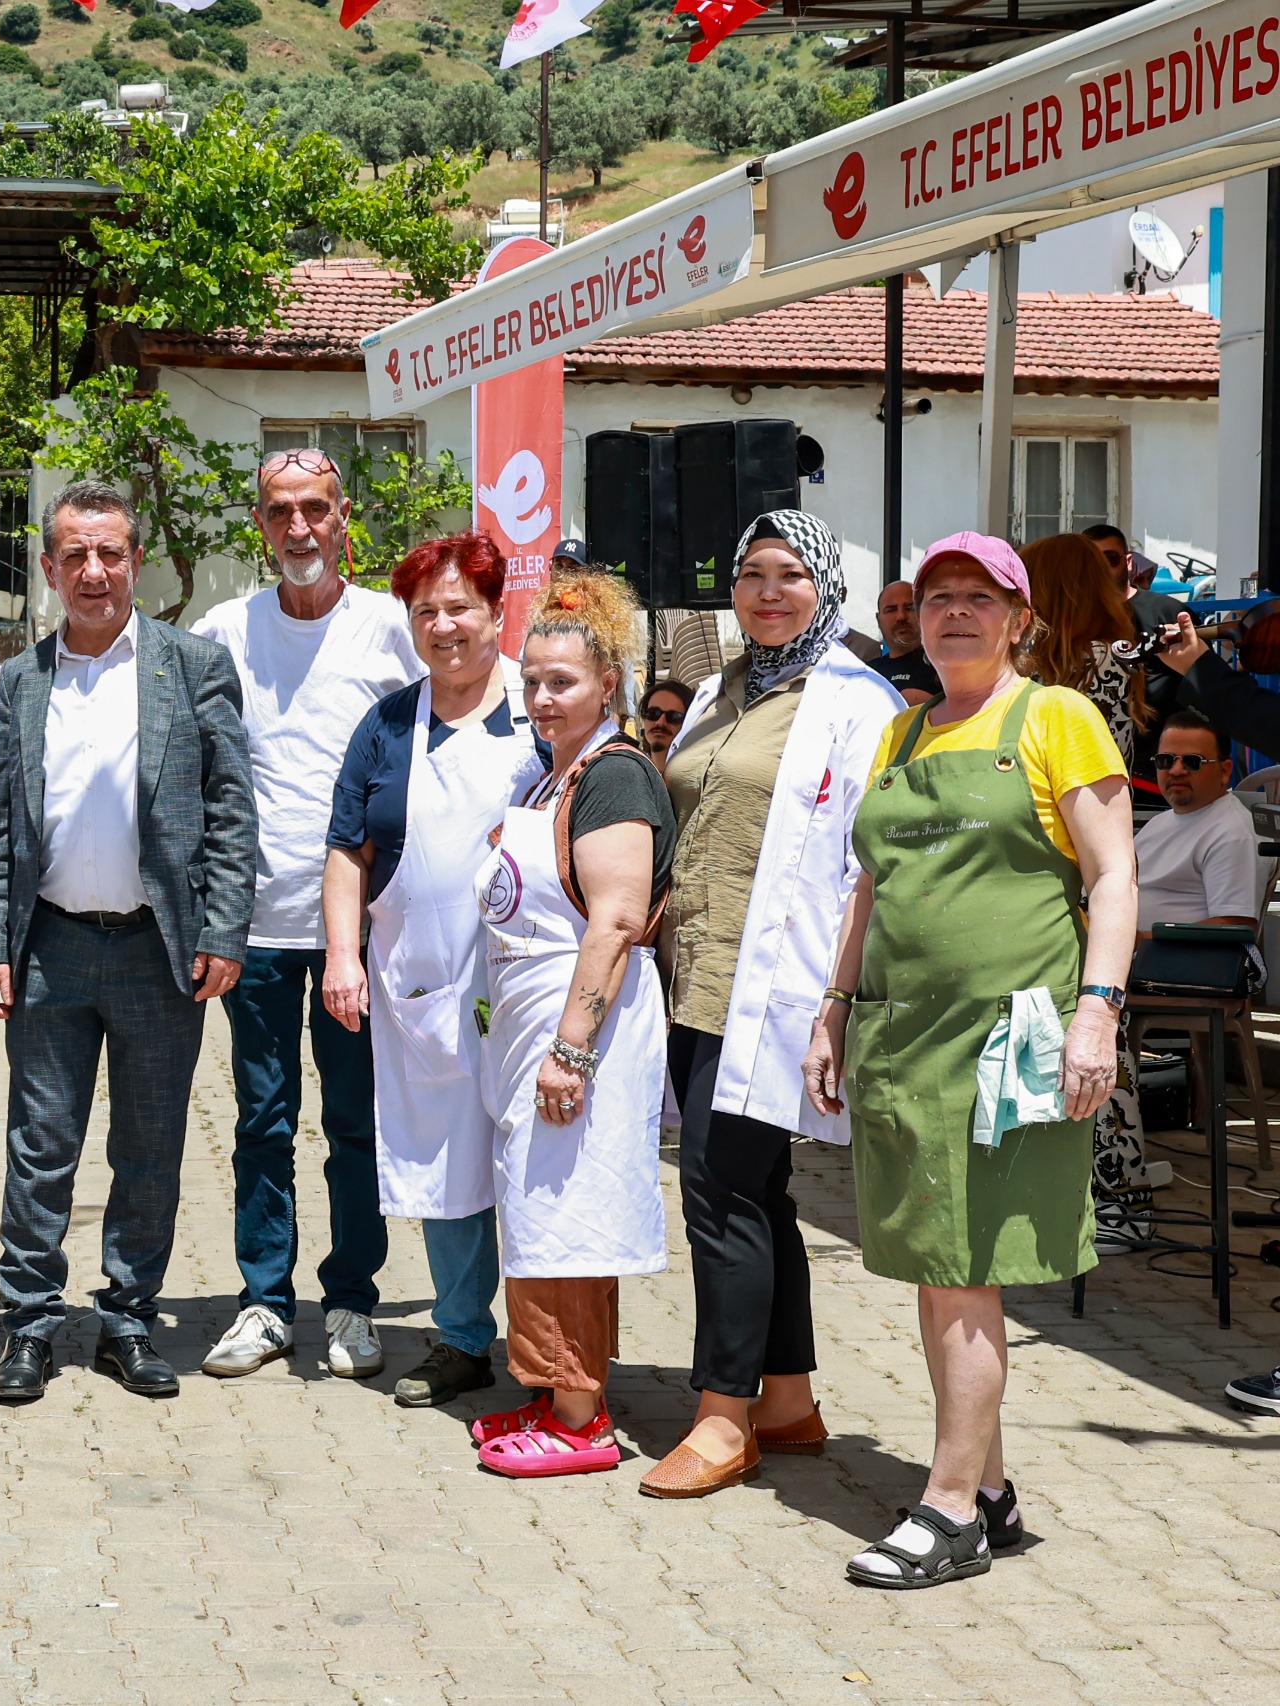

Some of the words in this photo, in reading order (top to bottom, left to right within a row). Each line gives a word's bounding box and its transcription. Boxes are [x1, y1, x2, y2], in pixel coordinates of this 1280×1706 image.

[900, 139, 942, 209] T.C.
[951, 95, 1062, 194] EFELER
[1080, 17, 1280, 151] BELEDİYES
[410, 344, 442, 391] T.C.
[446, 309, 521, 379] EFELER
[529, 231, 666, 346] BELEDİYESİ
[504, 555, 545, 578] FELER
[886, 825, 919, 839] Ressam
